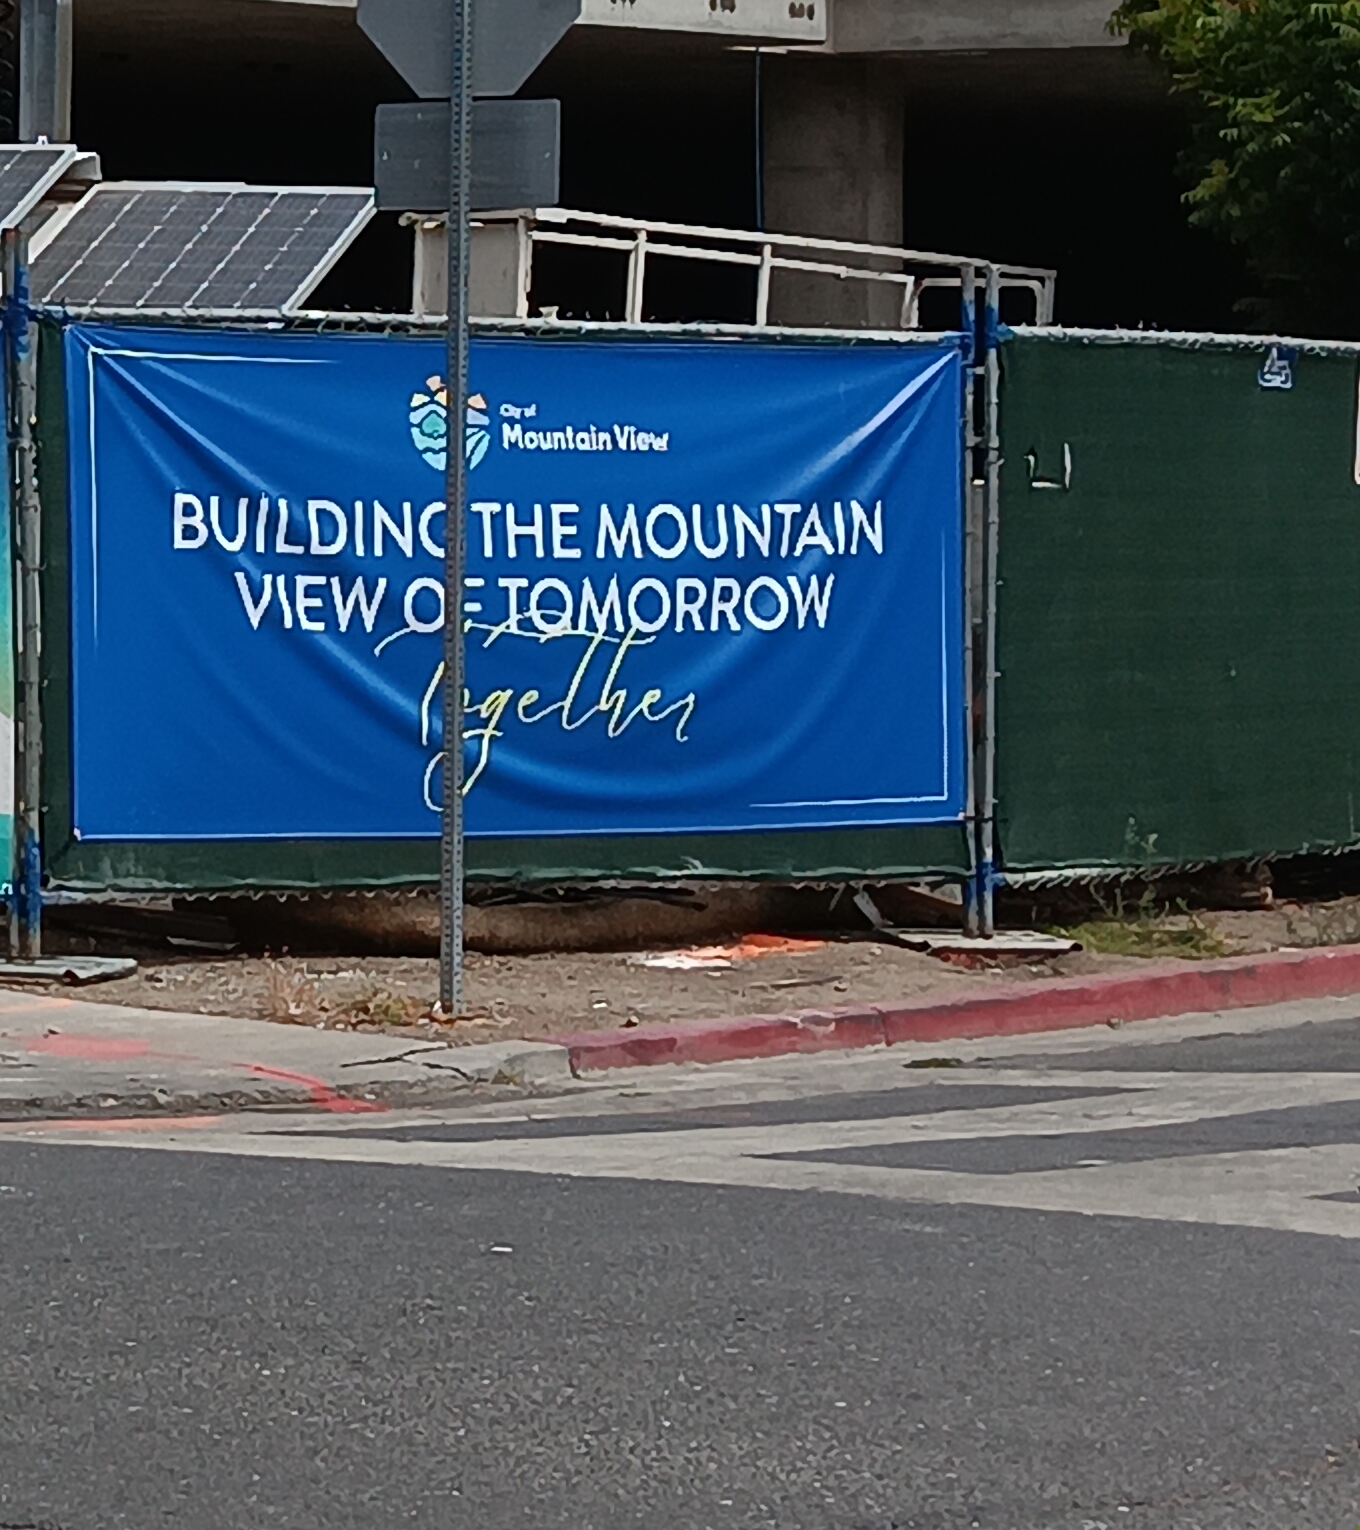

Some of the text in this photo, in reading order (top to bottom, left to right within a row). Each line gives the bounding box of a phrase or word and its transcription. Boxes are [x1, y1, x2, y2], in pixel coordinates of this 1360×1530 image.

[501, 422, 669, 451] Mountain View
[470, 502, 581, 559] THE
[595, 500, 884, 560] MOUNTAIN
[234, 571, 387, 632] VIEW
[497, 573, 835, 634] TOMORROW
[374, 608, 696, 813] Tgether
